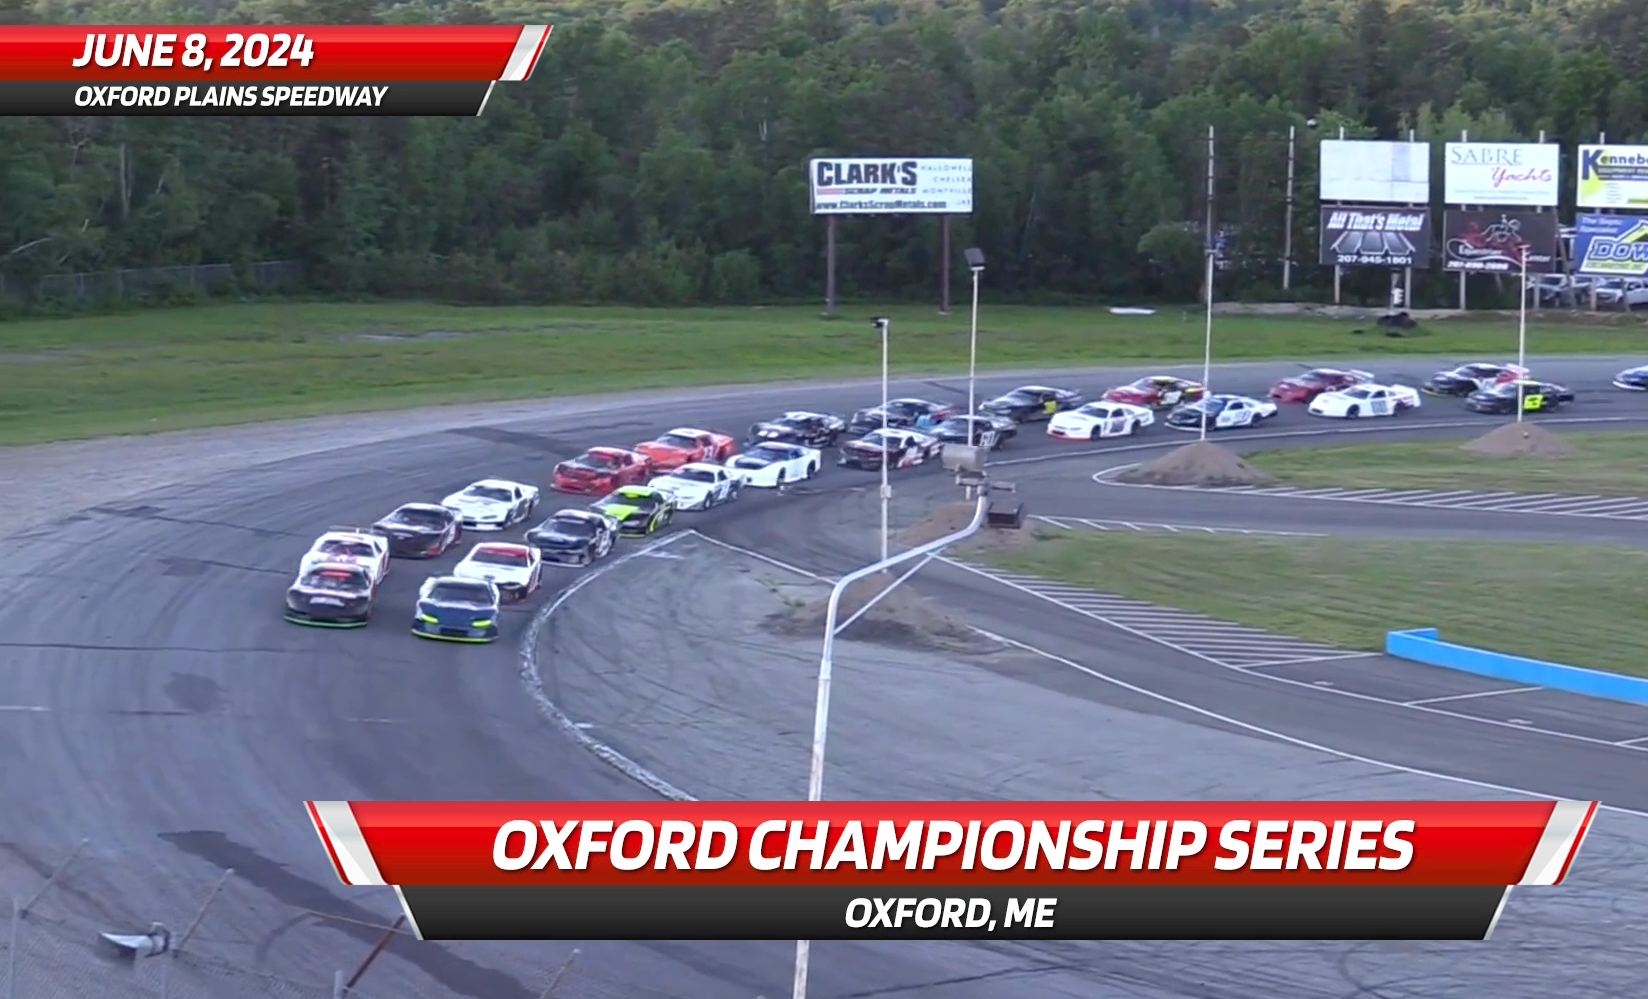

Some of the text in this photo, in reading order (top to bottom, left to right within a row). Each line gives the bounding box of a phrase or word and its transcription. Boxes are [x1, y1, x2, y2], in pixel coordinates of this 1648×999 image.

[1451, 146, 1522, 166] SABRE
[1582, 149, 1648, 181] Kenneb
[817, 161, 918, 187] CLARK'S
[1491, 166, 1552, 188] Yachts
[1326, 211, 1426, 231] All That's Metal
